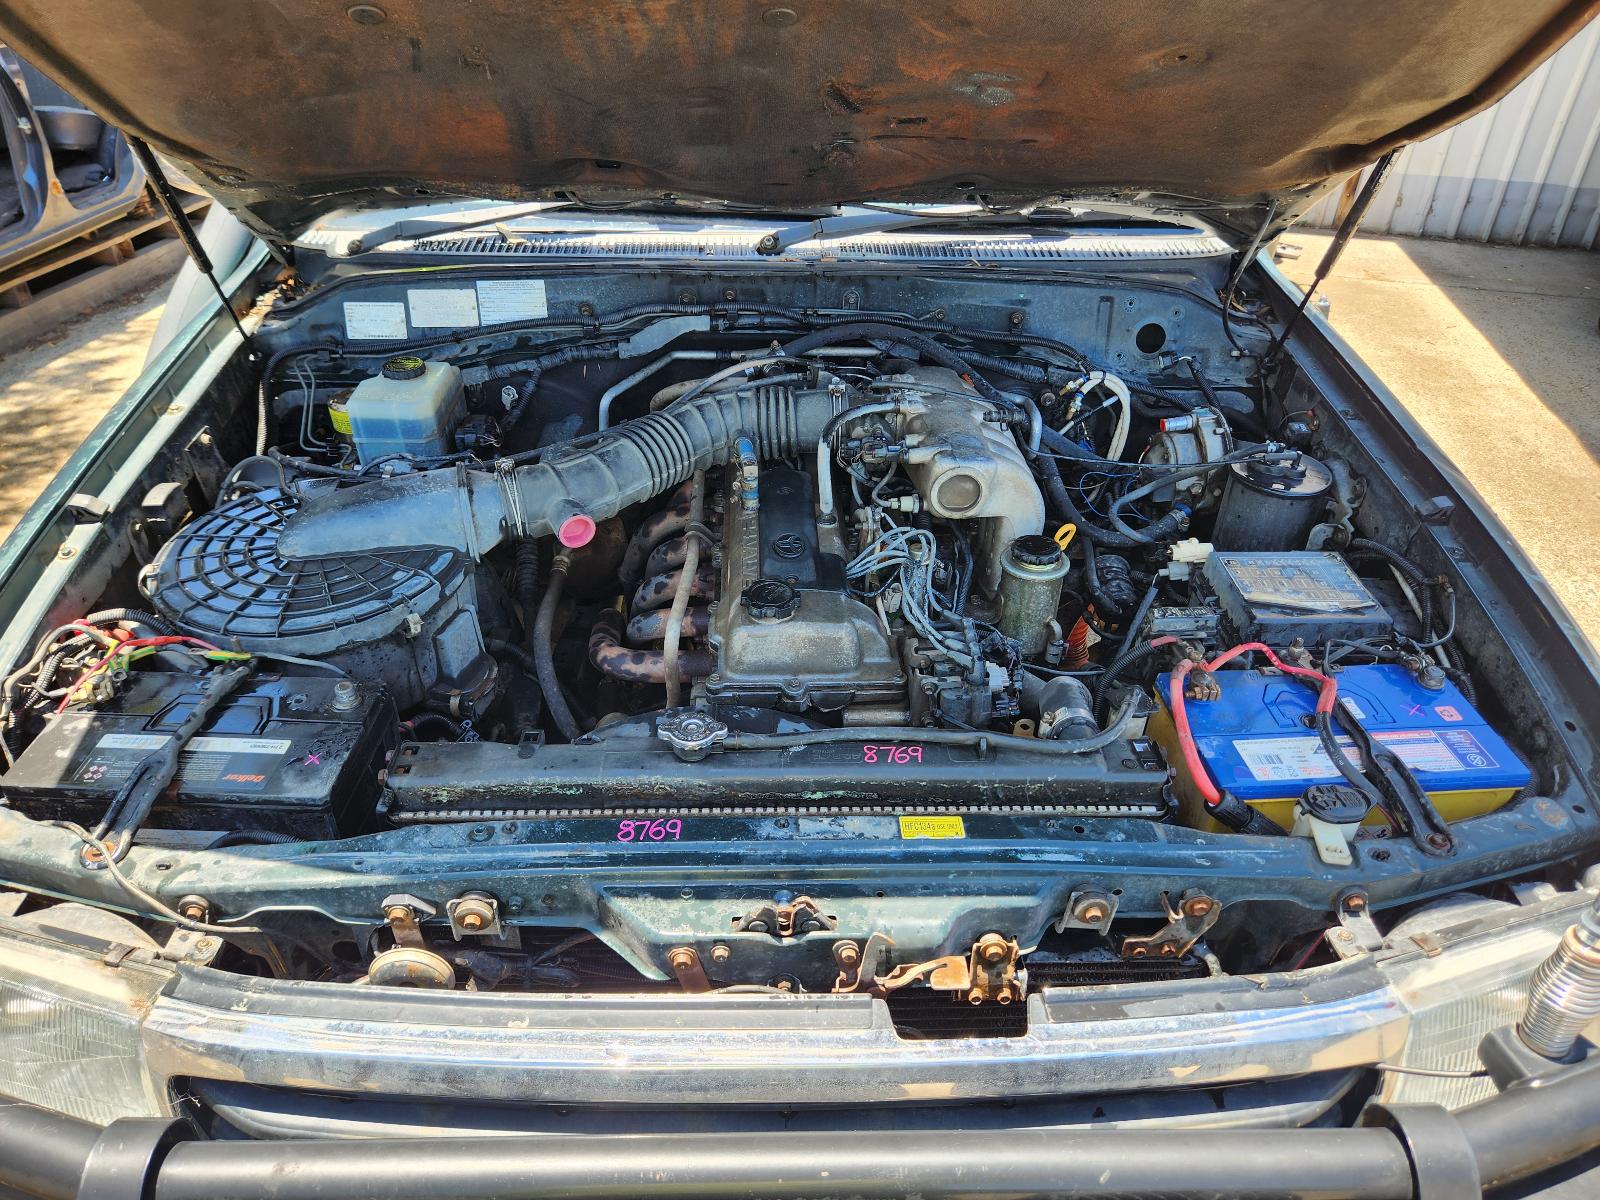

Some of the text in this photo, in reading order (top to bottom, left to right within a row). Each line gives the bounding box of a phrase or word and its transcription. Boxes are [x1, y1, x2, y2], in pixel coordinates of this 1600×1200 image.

[863, 745, 923, 764] 8769
[223, 774, 266, 783] Delkor
[617, 819, 683, 842] 8769
